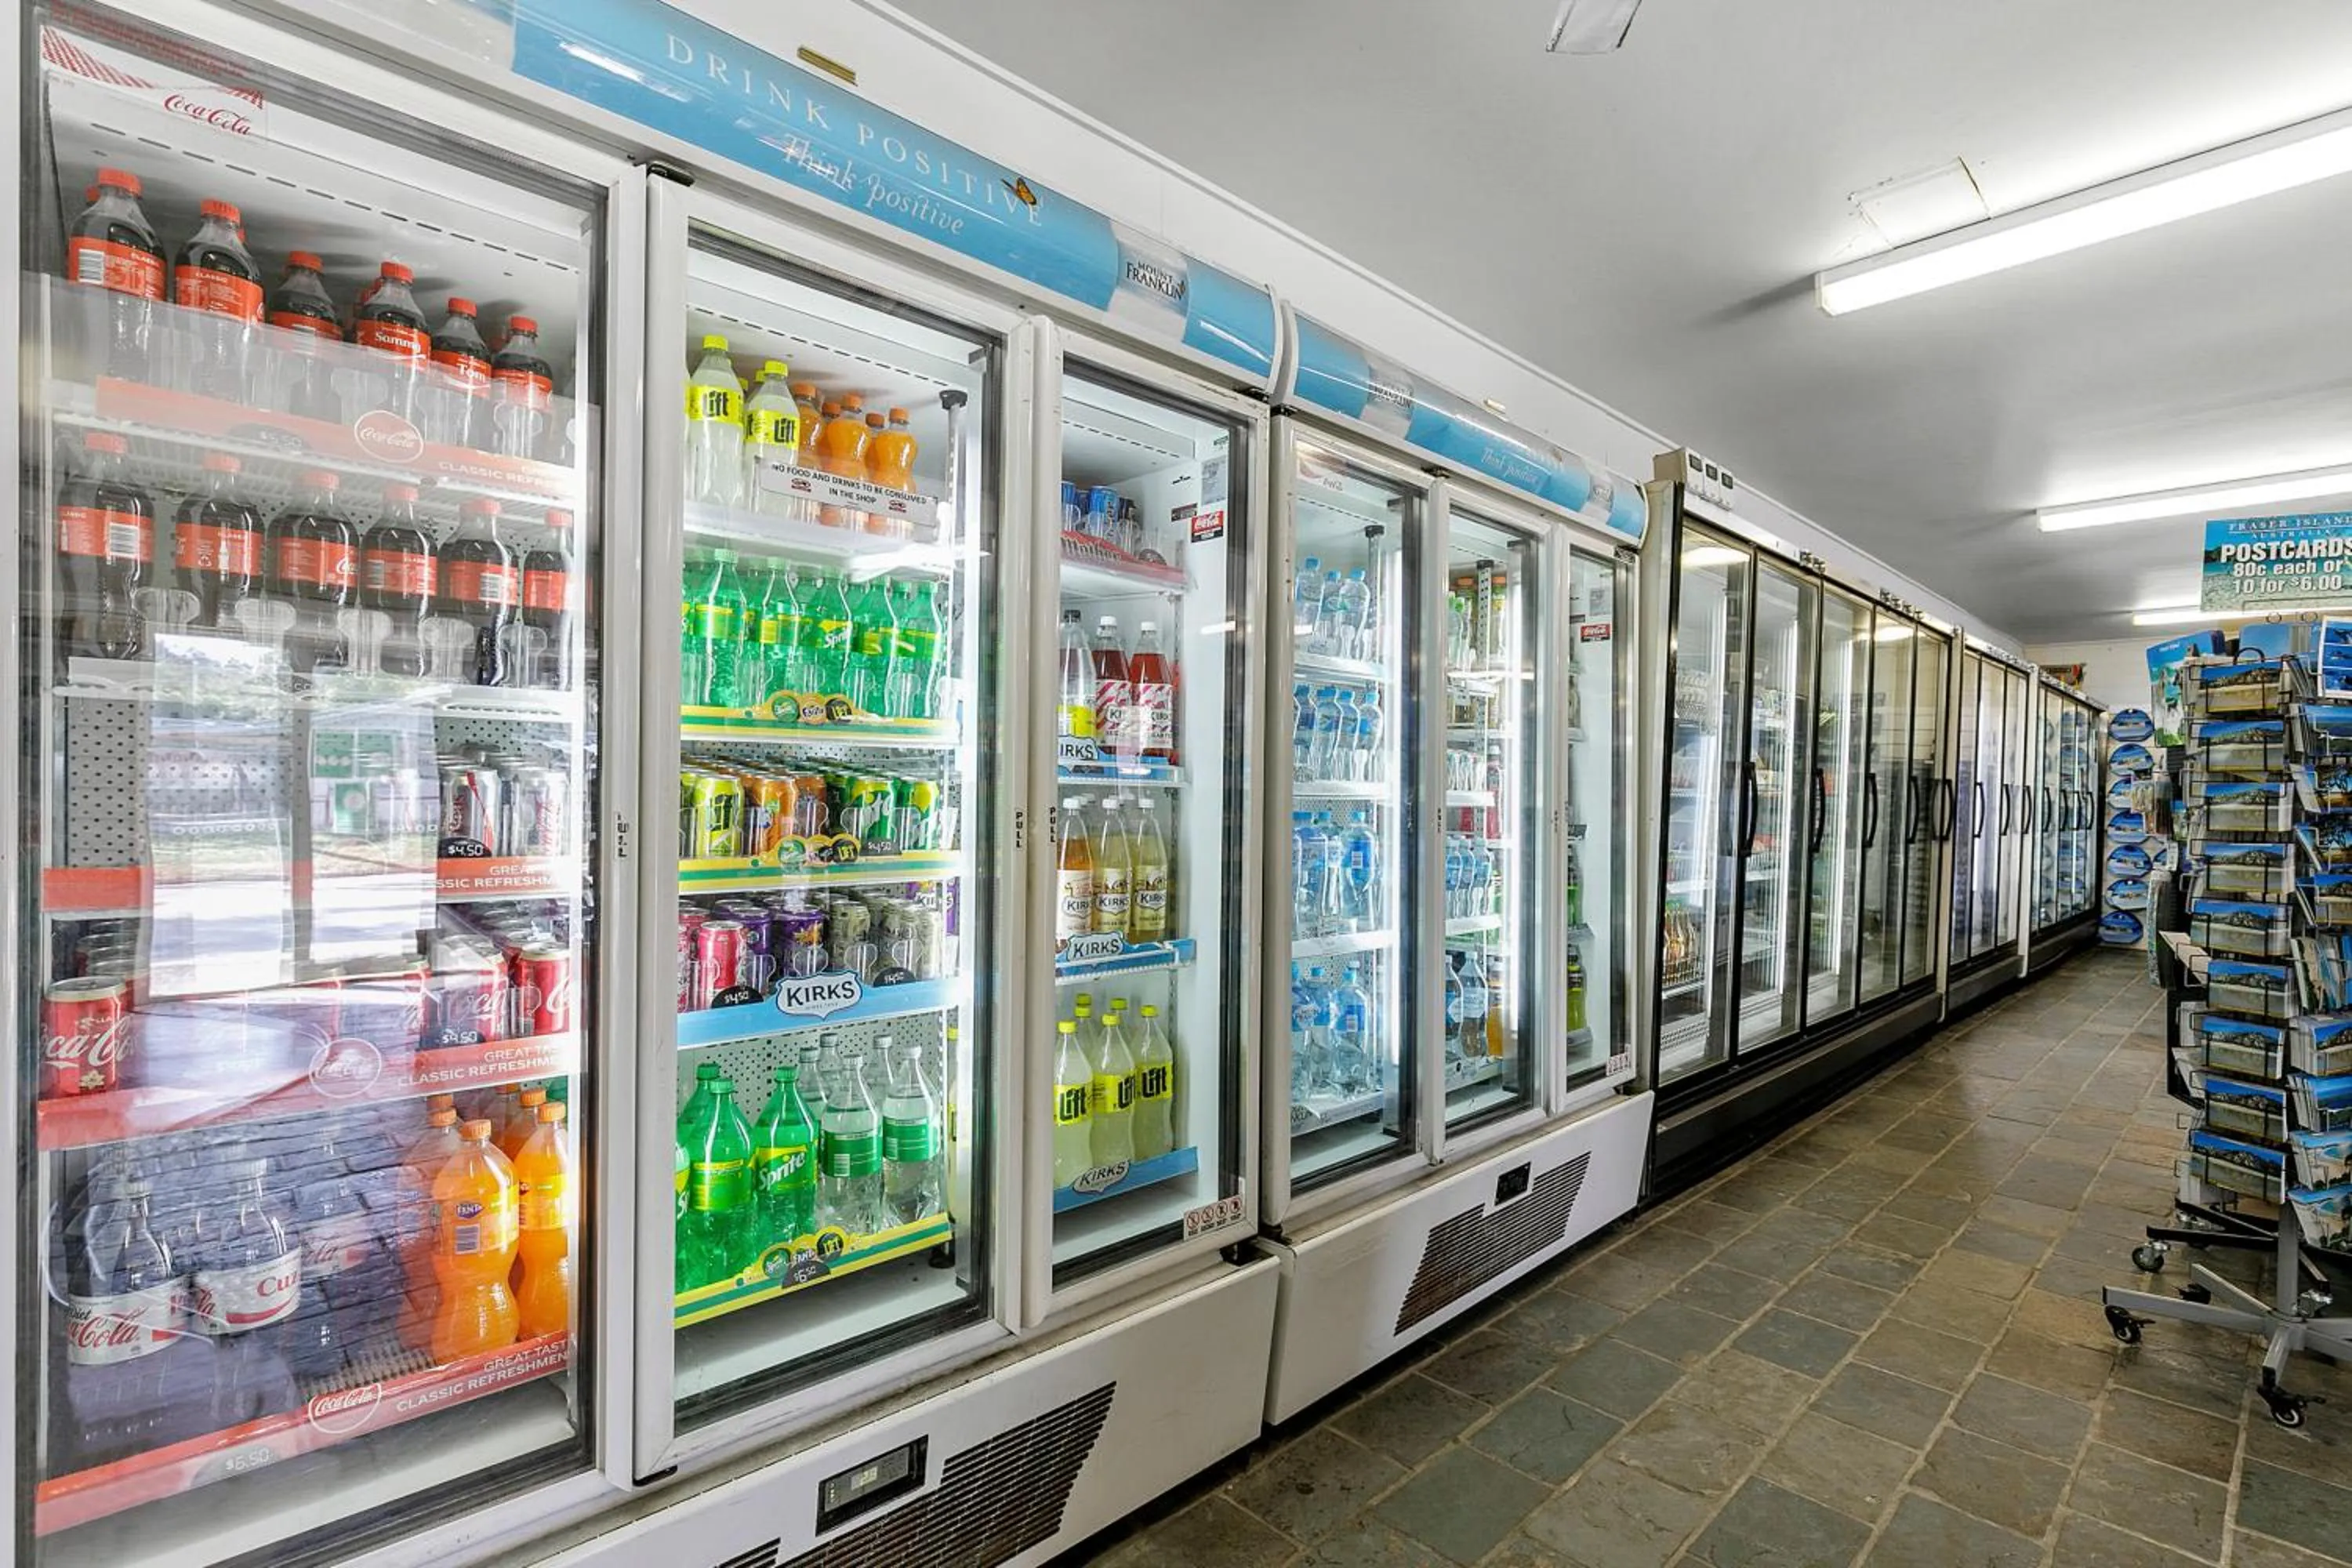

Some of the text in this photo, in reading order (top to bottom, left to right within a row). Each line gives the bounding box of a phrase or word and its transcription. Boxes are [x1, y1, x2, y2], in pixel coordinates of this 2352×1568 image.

[667, 34, 1043, 227] DRINK POSITIVE
[783, 132, 964, 236] Think positive
[1126, 262, 1183, 300] FRANKLIN
[1138, 261, 1174, 284] MOUNT
[457, 364, 486, 383] Tom
[786, 466, 811, 478] FOOD
[811, 471, 831, 482] AND
[832, 476, 860, 490] DRINKS
[862, 483, 873, 493] TO
[874, 485, 884, 495] BE
[829, 487, 877, 504] IN THE SHOP
[2229, 519, 2288, 531] FRASER
[2252, 529, 2332, 539] AUSTRALIA
[2220, 538, 2352, 564] POSTCARDS
[2234, 560, 2344, 578] 80c each or
[2233, 575, 2343, 594] 10 for $6.00
[1060, 744, 1094, 760] IRKS
[448, 844, 484, 857] $4.50
[1073, 938, 1120, 958] KIRKS
[786, 980, 856, 1007] KIRKS
[483, 1047, 532, 1062] GREAT
[398, 1068, 465, 1087] CLASSIC
[1142, 1065, 1167, 1098] Lift
[1059, 1086, 1087, 1122] Lift
[758, 1152, 805, 1192] Sprite
[1079, 1160, 1126, 1186] KIRKS
[483, 1339, 568, 1372] GREAT TAST
[396, 1352, 569, 1412] CLASSIC REFRESHMEN
